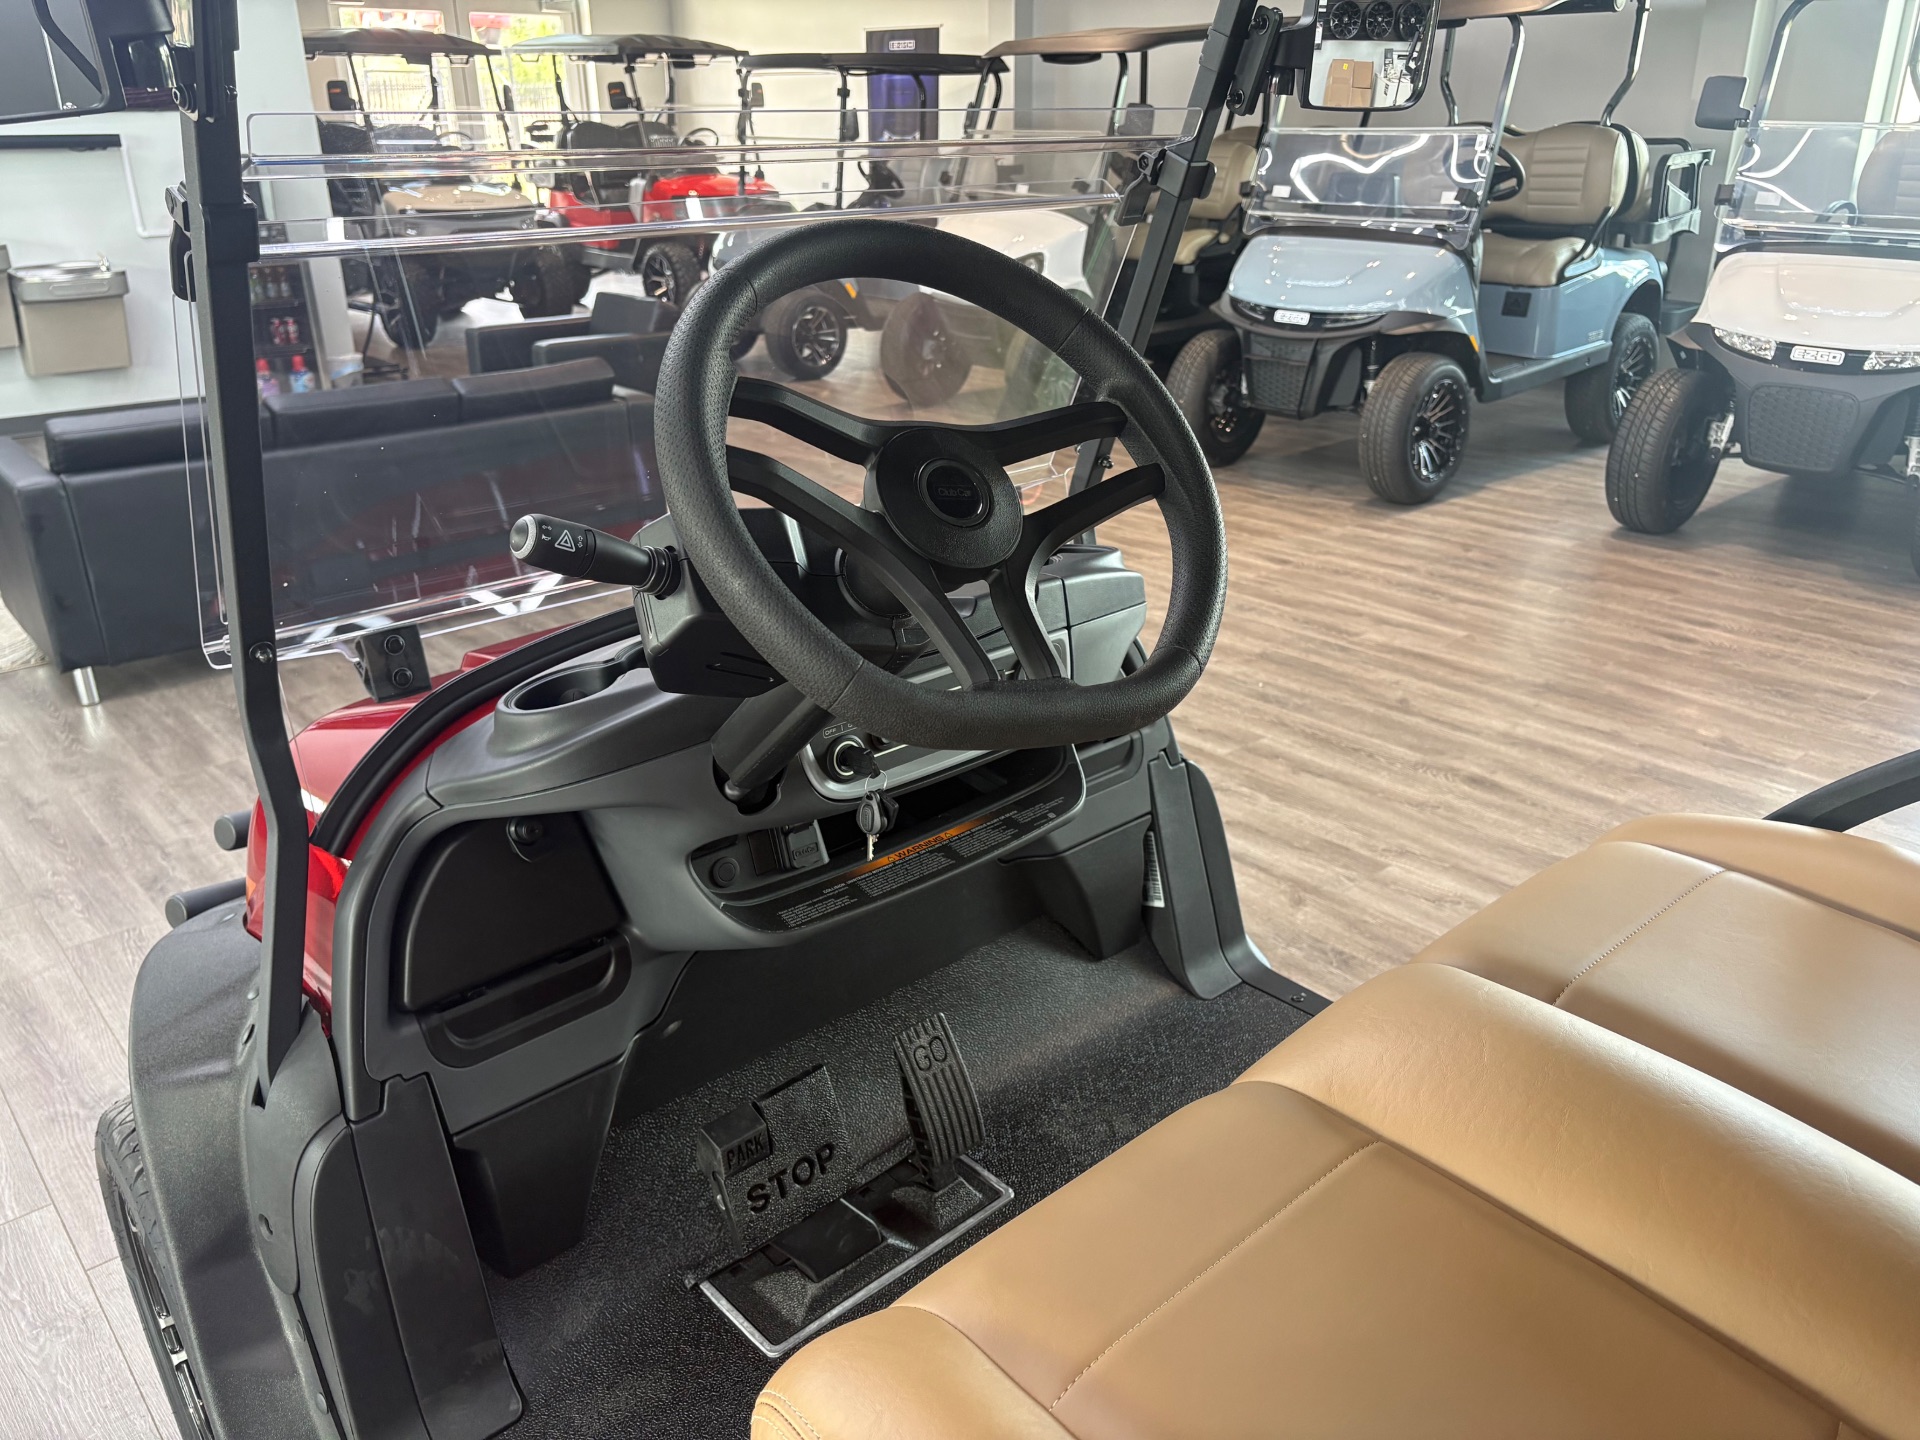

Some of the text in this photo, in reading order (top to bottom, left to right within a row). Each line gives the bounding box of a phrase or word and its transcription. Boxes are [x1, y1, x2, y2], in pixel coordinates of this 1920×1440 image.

[895, 835, 944, 858] WARNING
[913, 1036, 947, 1071] GO
[726, 1132, 764, 1170] PARK
[747, 1142, 836, 1213] STOP
